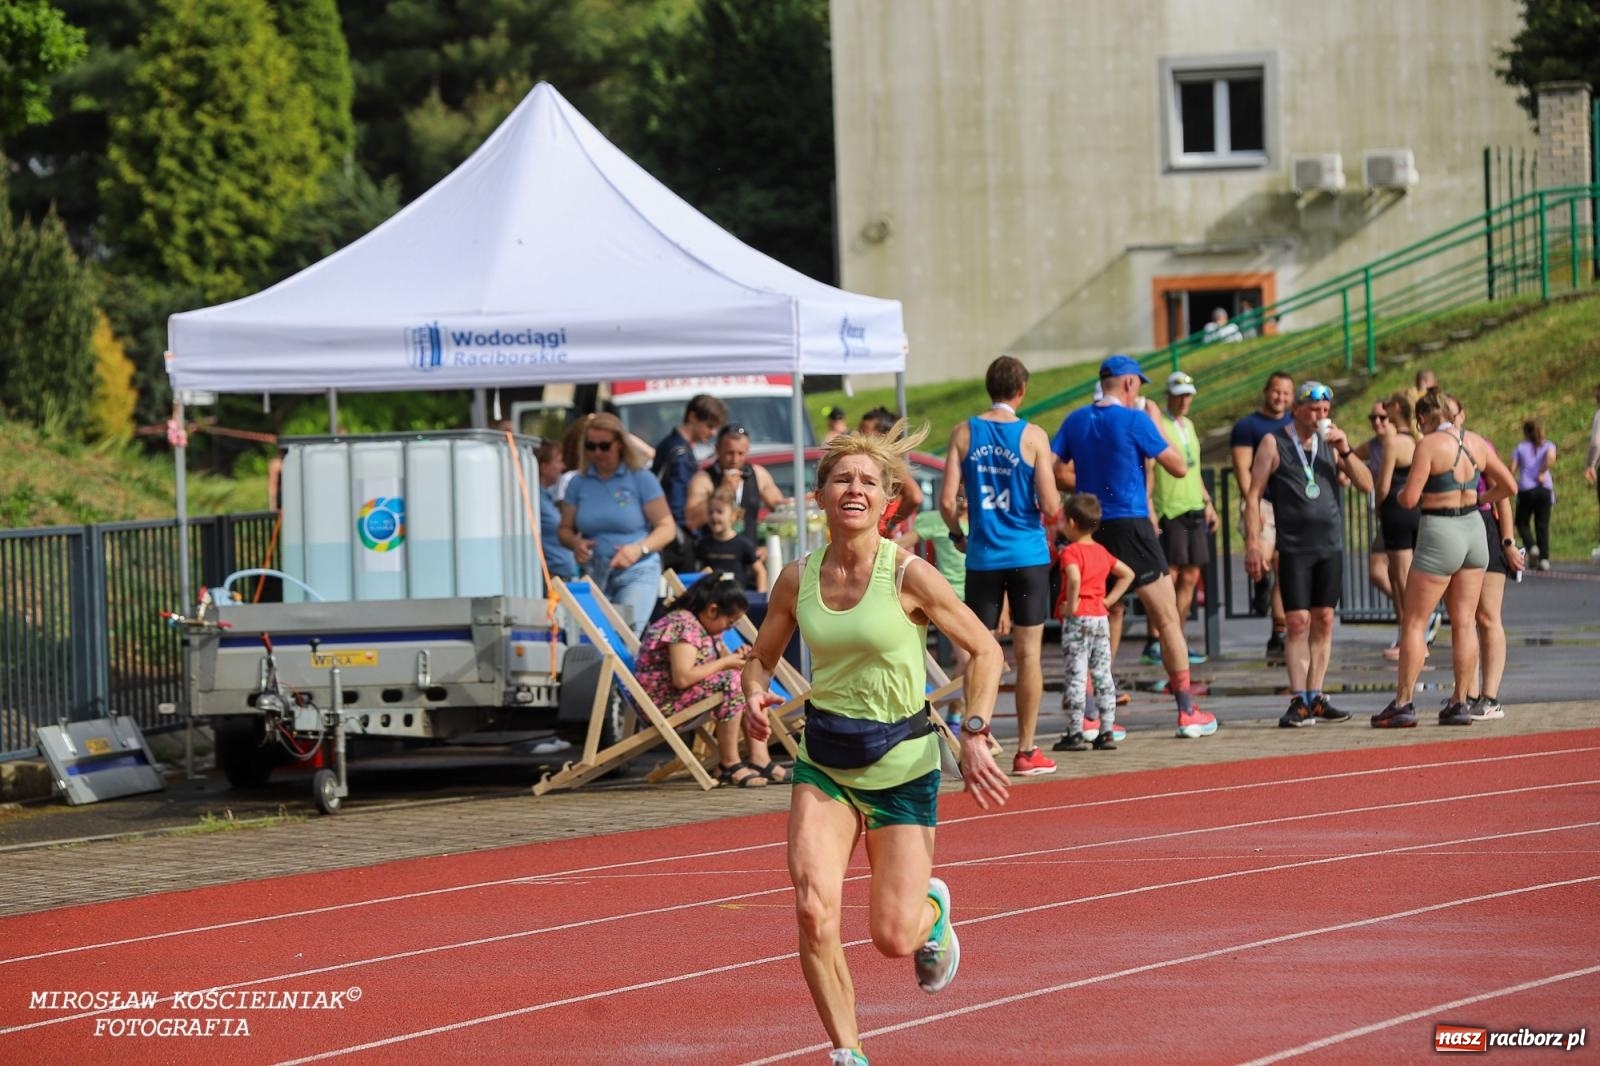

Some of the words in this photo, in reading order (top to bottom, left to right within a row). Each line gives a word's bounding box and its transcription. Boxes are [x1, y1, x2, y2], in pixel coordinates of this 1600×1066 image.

[451, 328, 566, 348] Wodociągi
[455, 349, 568, 366] Raciborskie
[970, 444, 1020, 467] VICTORIA
[980, 485, 1011, 513] 24
